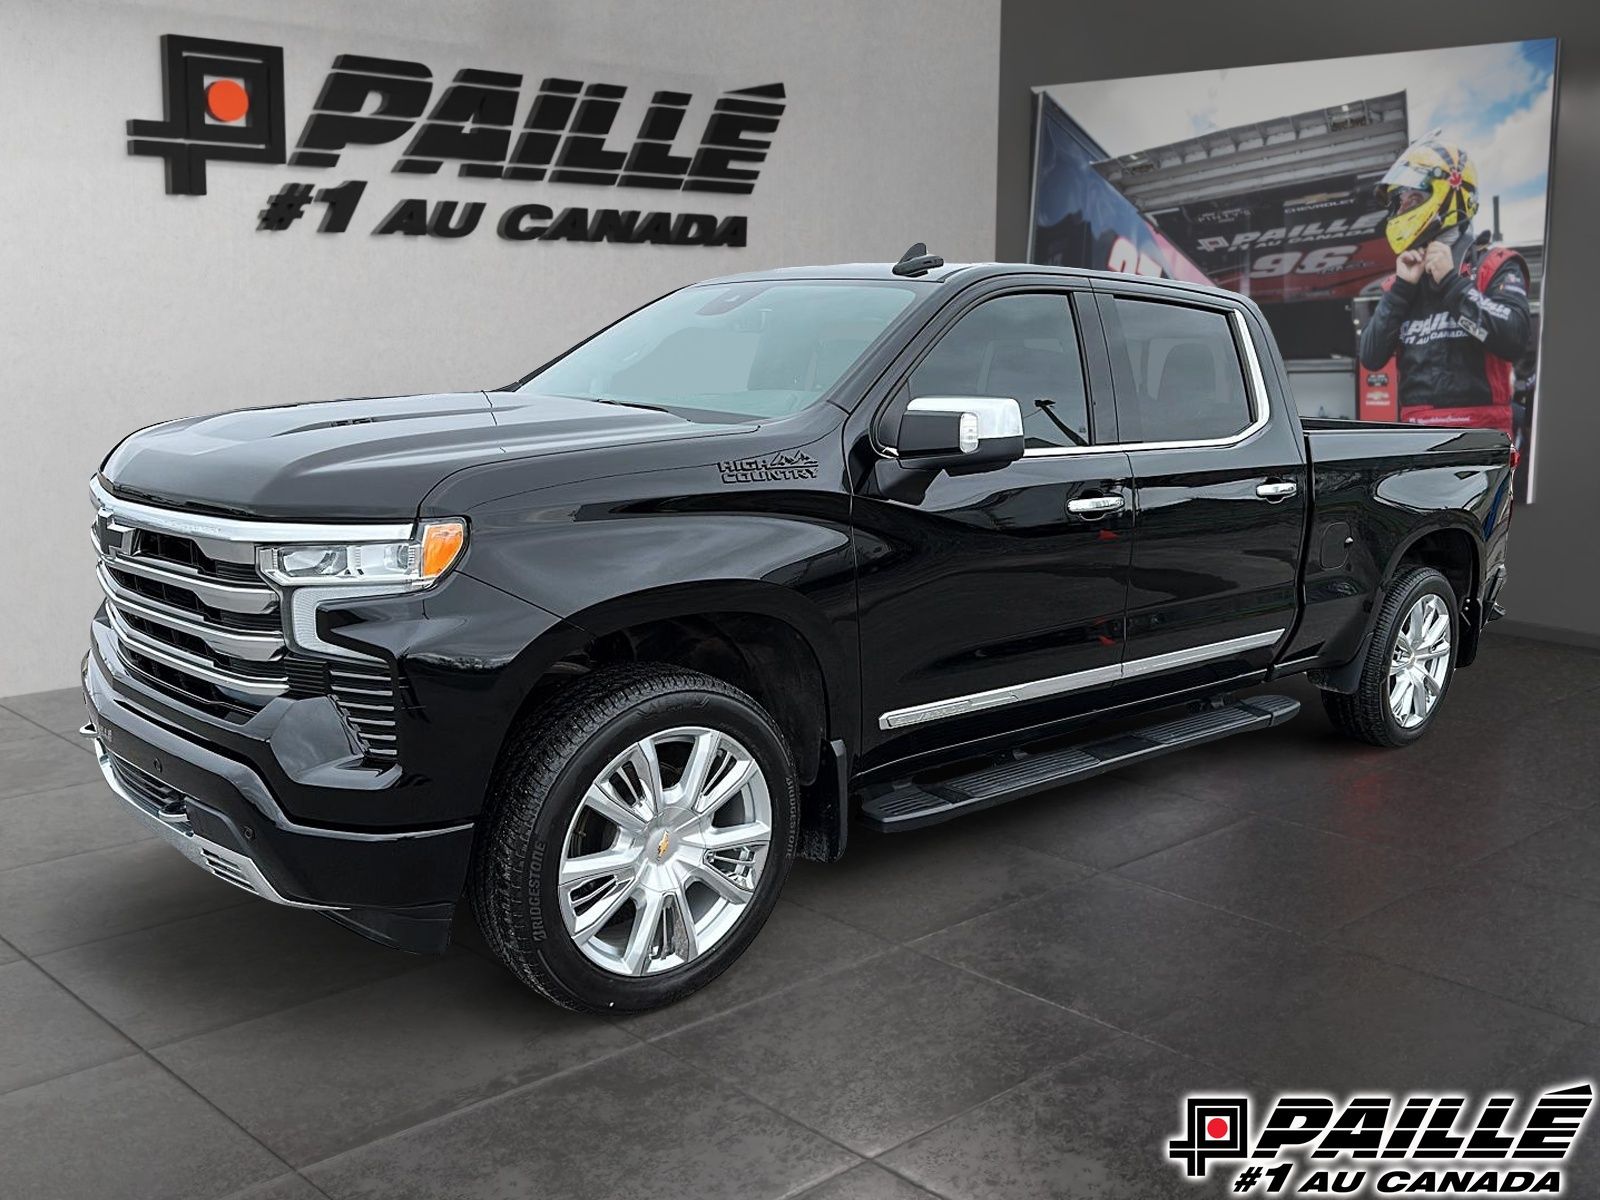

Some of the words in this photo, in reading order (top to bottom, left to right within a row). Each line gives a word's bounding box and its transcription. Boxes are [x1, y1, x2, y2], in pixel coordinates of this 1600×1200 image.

[287, 54, 786, 194] PAILLÉ
[256, 180, 369, 233] #1
[370, 198, 488, 238] AU
[496, 203, 748, 247] CANADA
[1287, 228, 1375, 244] CANADA
[1251, 245, 1358, 279] 96
[717, 459, 768, 473] HIGH
[721, 467, 818, 484] COUNTRY
[528, 840, 547, 942] BRIDGESTONE
